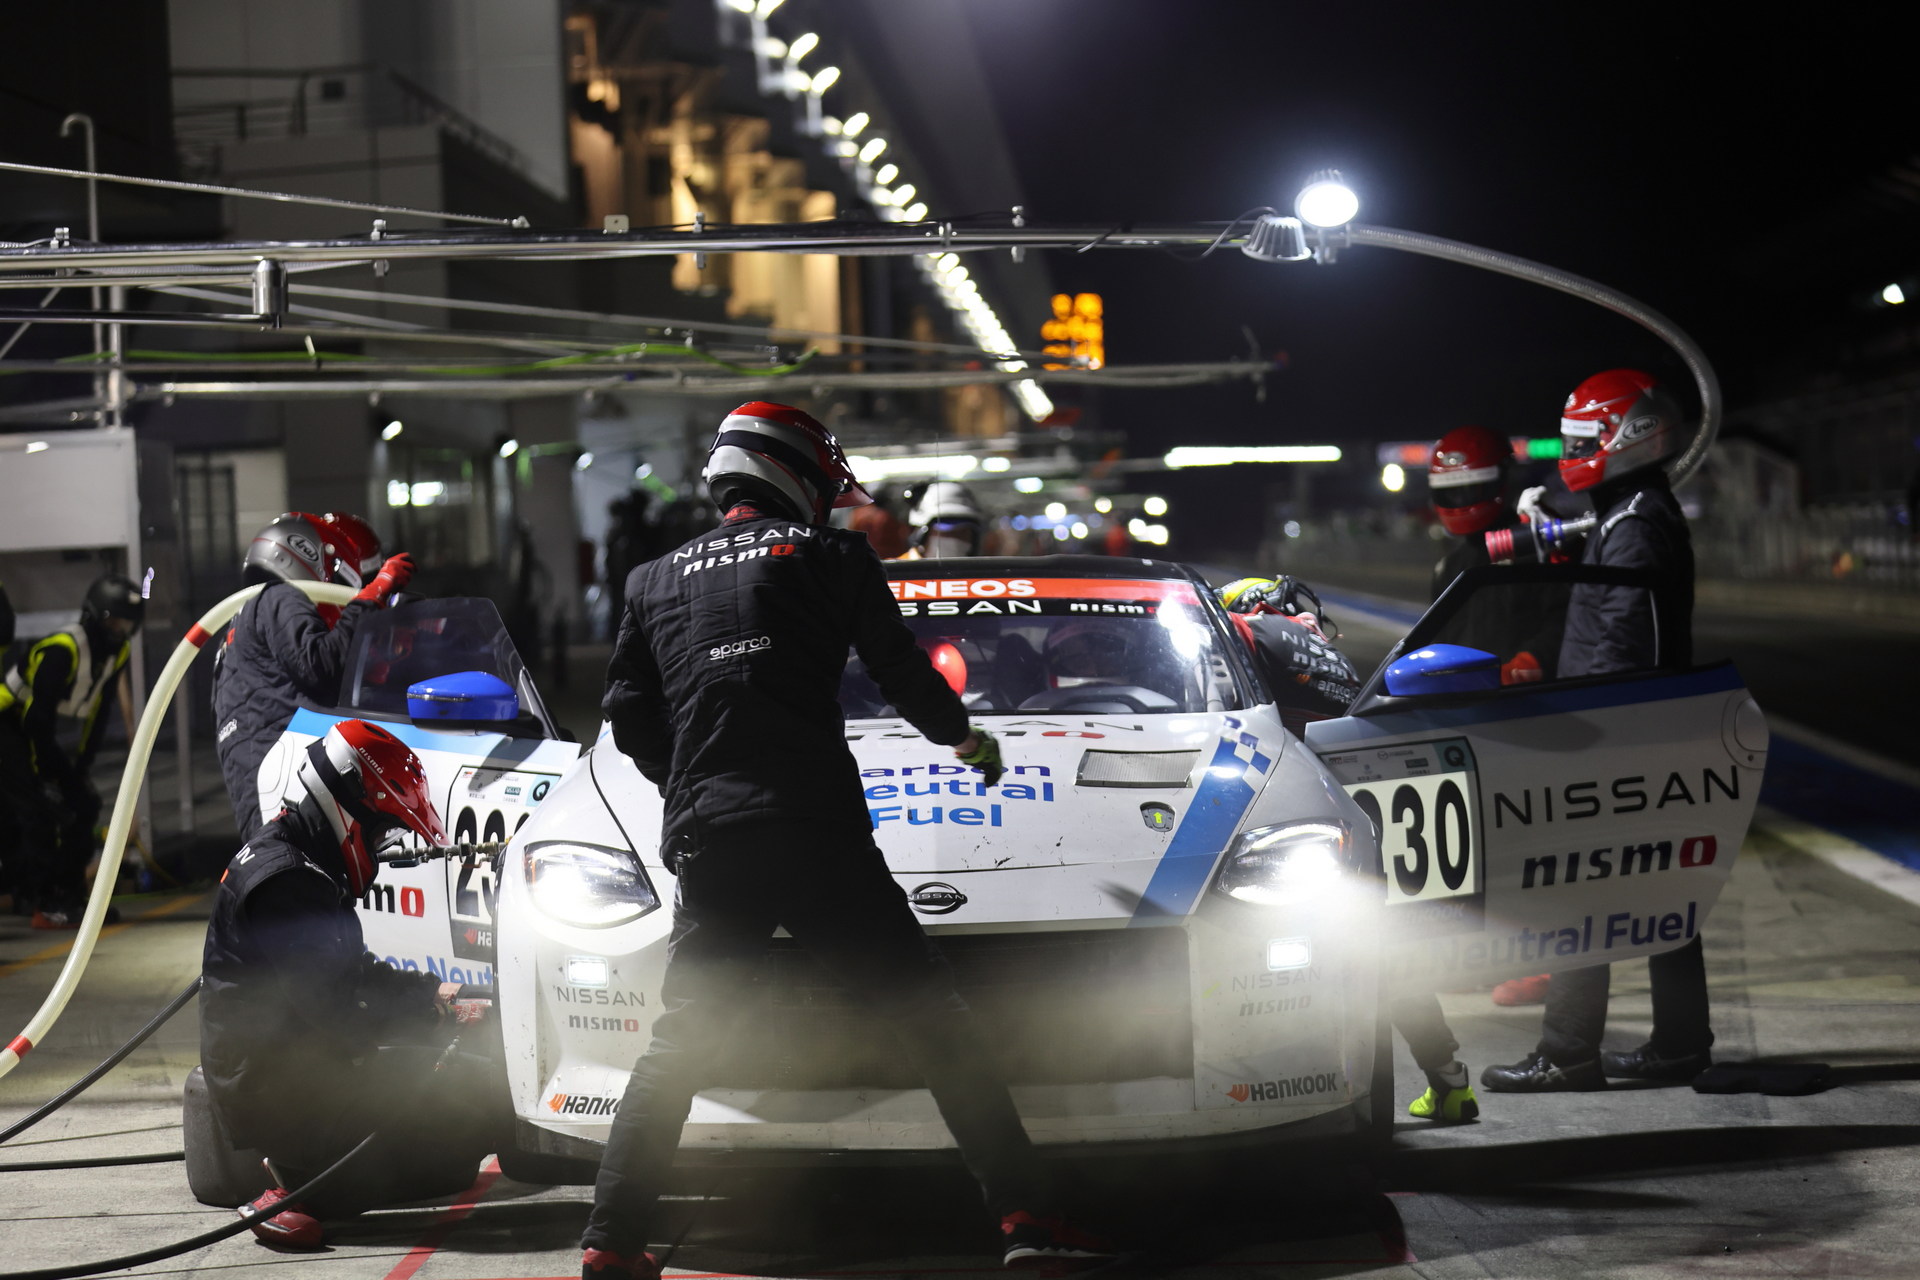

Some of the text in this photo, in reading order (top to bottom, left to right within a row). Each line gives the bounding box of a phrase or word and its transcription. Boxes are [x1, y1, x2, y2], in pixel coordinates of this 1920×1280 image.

[672, 526, 811, 564] NISSAN
[683, 544, 796, 576] nismo
[897, 600, 1042, 617] SSAN
[710, 635, 772, 660] sparco
[359, 747, 384, 774] nismo
[1444, 745, 1466, 767] Q
[864, 779, 1054, 802] eutral
[1493, 764, 1741, 829] NISSAN
[868, 803, 1002, 830] Fuel
[1521, 834, 1718, 889] nismo
[1604, 901, 1697, 950] Fuel
[1232, 966, 1321, 992] NISSAN
[557, 986, 645, 1007] NISSAN
[1239, 995, 1311, 1017] nismo
[569, 1015, 639, 1032] nismo
